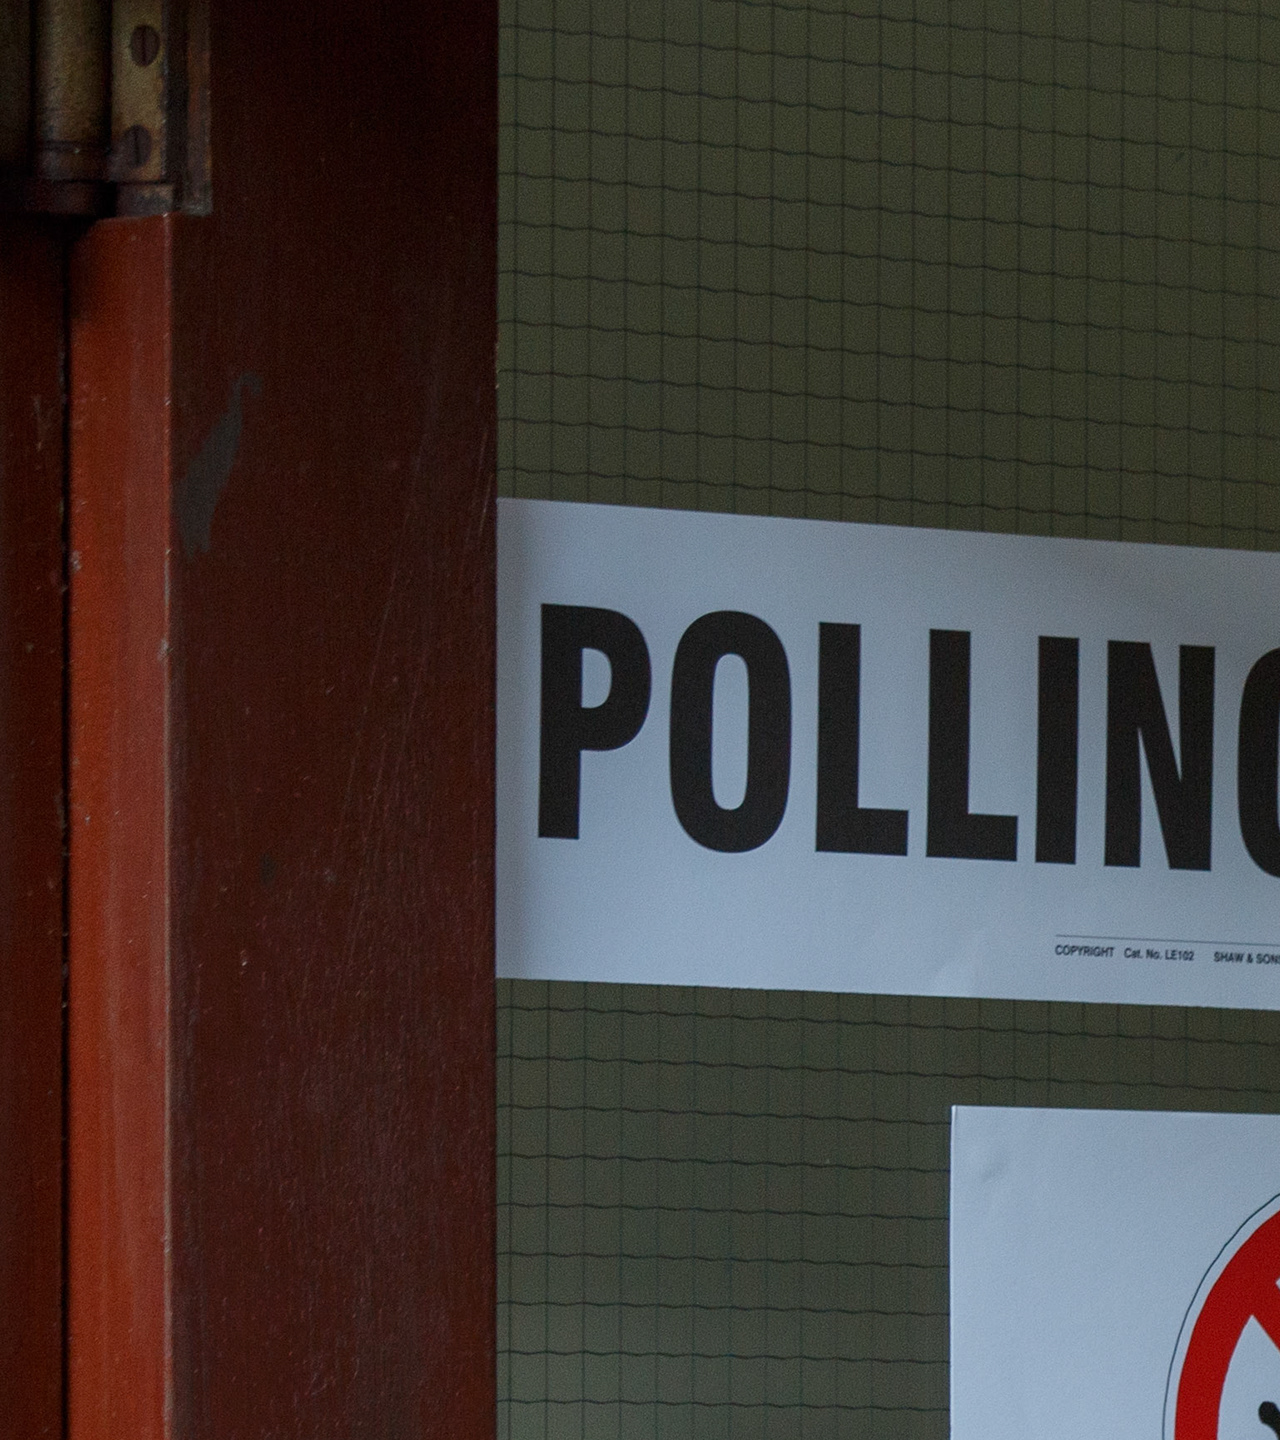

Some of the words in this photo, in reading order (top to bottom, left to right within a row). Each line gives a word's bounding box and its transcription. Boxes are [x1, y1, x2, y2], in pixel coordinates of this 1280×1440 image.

[1055, 945, 1114, 957] COPYRIGHT
[1124, 947, 1143, 959] Cat.
[1146, 949, 1162, 959] No.
[1165, 950, 1194, 961] LE102
[1214, 951, 1244, 963] SHAW
[1246, 953, 1254, 964] &
